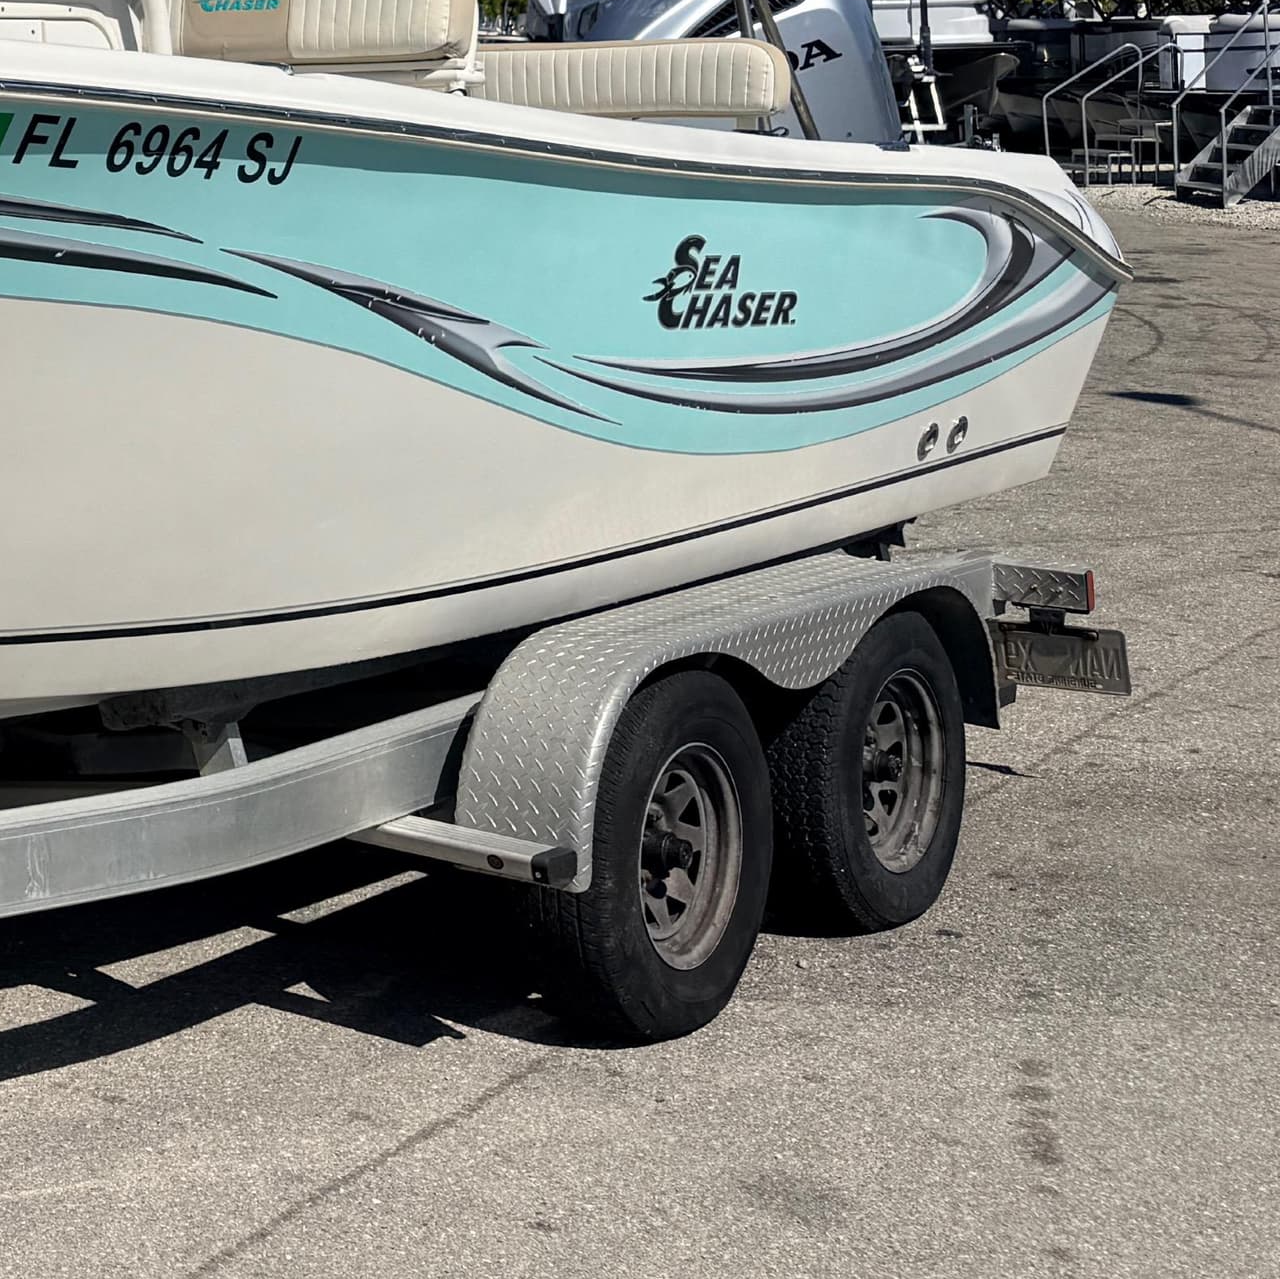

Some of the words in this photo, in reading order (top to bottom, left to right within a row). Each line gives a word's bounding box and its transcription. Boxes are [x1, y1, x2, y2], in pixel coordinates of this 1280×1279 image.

[12, 113, 80, 169] FL
[105, 121, 230, 181] 6964
[238, 131, 303, 186] SJ
[674, 234, 742, 291] SEA
